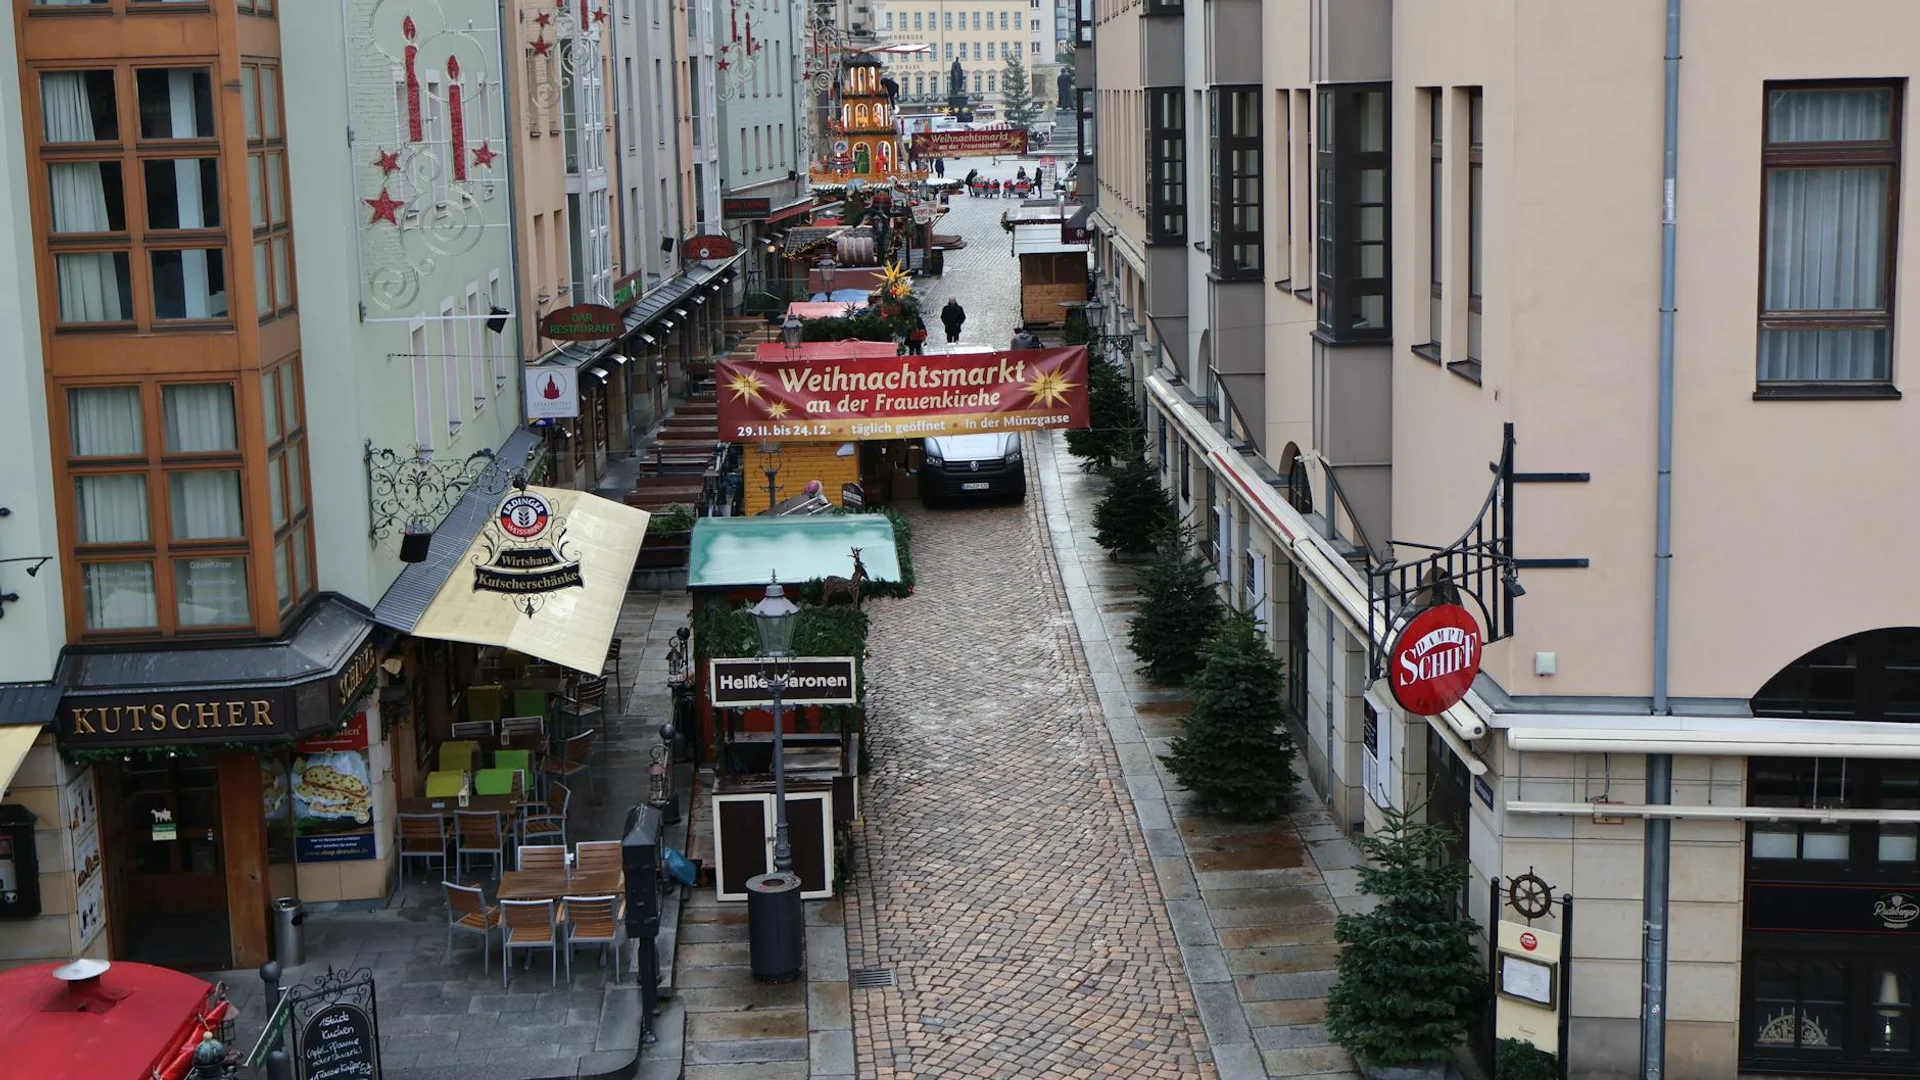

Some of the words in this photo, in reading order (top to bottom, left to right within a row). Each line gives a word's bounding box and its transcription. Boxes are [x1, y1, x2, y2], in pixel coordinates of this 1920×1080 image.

[931, 132, 1008, 144] Weihnachtsmarkt
[961, 141, 1000, 150] Frauenkirche
[572, 313, 592, 322] BAR
[550, 323, 616, 334] RESTAURANT
[777, 357, 1025, 394] Weihnachtsmarkt
[806, 402, 831, 413] an
[837, 394, 868, 412] der
[875, 388, 1000, 412] Frauenkirche
[774, 425, 791, 436] bis
[851, 422, 891, 436] täglich
[896, 421, 946, 435] geöffnet
[981, 417, 999, 429] der
[1004, 414, 1069, 427] Münzgasse
[503, 498, 544, 515] ERDINGER
[501, 555, 553, 567] Wirtshaus
[478, 570, 578, 589] Kutscherschänke
[720, 674, 769, 689] Heiße
[774, 673, 847, 688] Maronen
[72, 700, 274, 734] KUTSCHER
[1873, 901, 1917, 919] Radeberger
[322, 1025, 355, 1040] Kuchen
